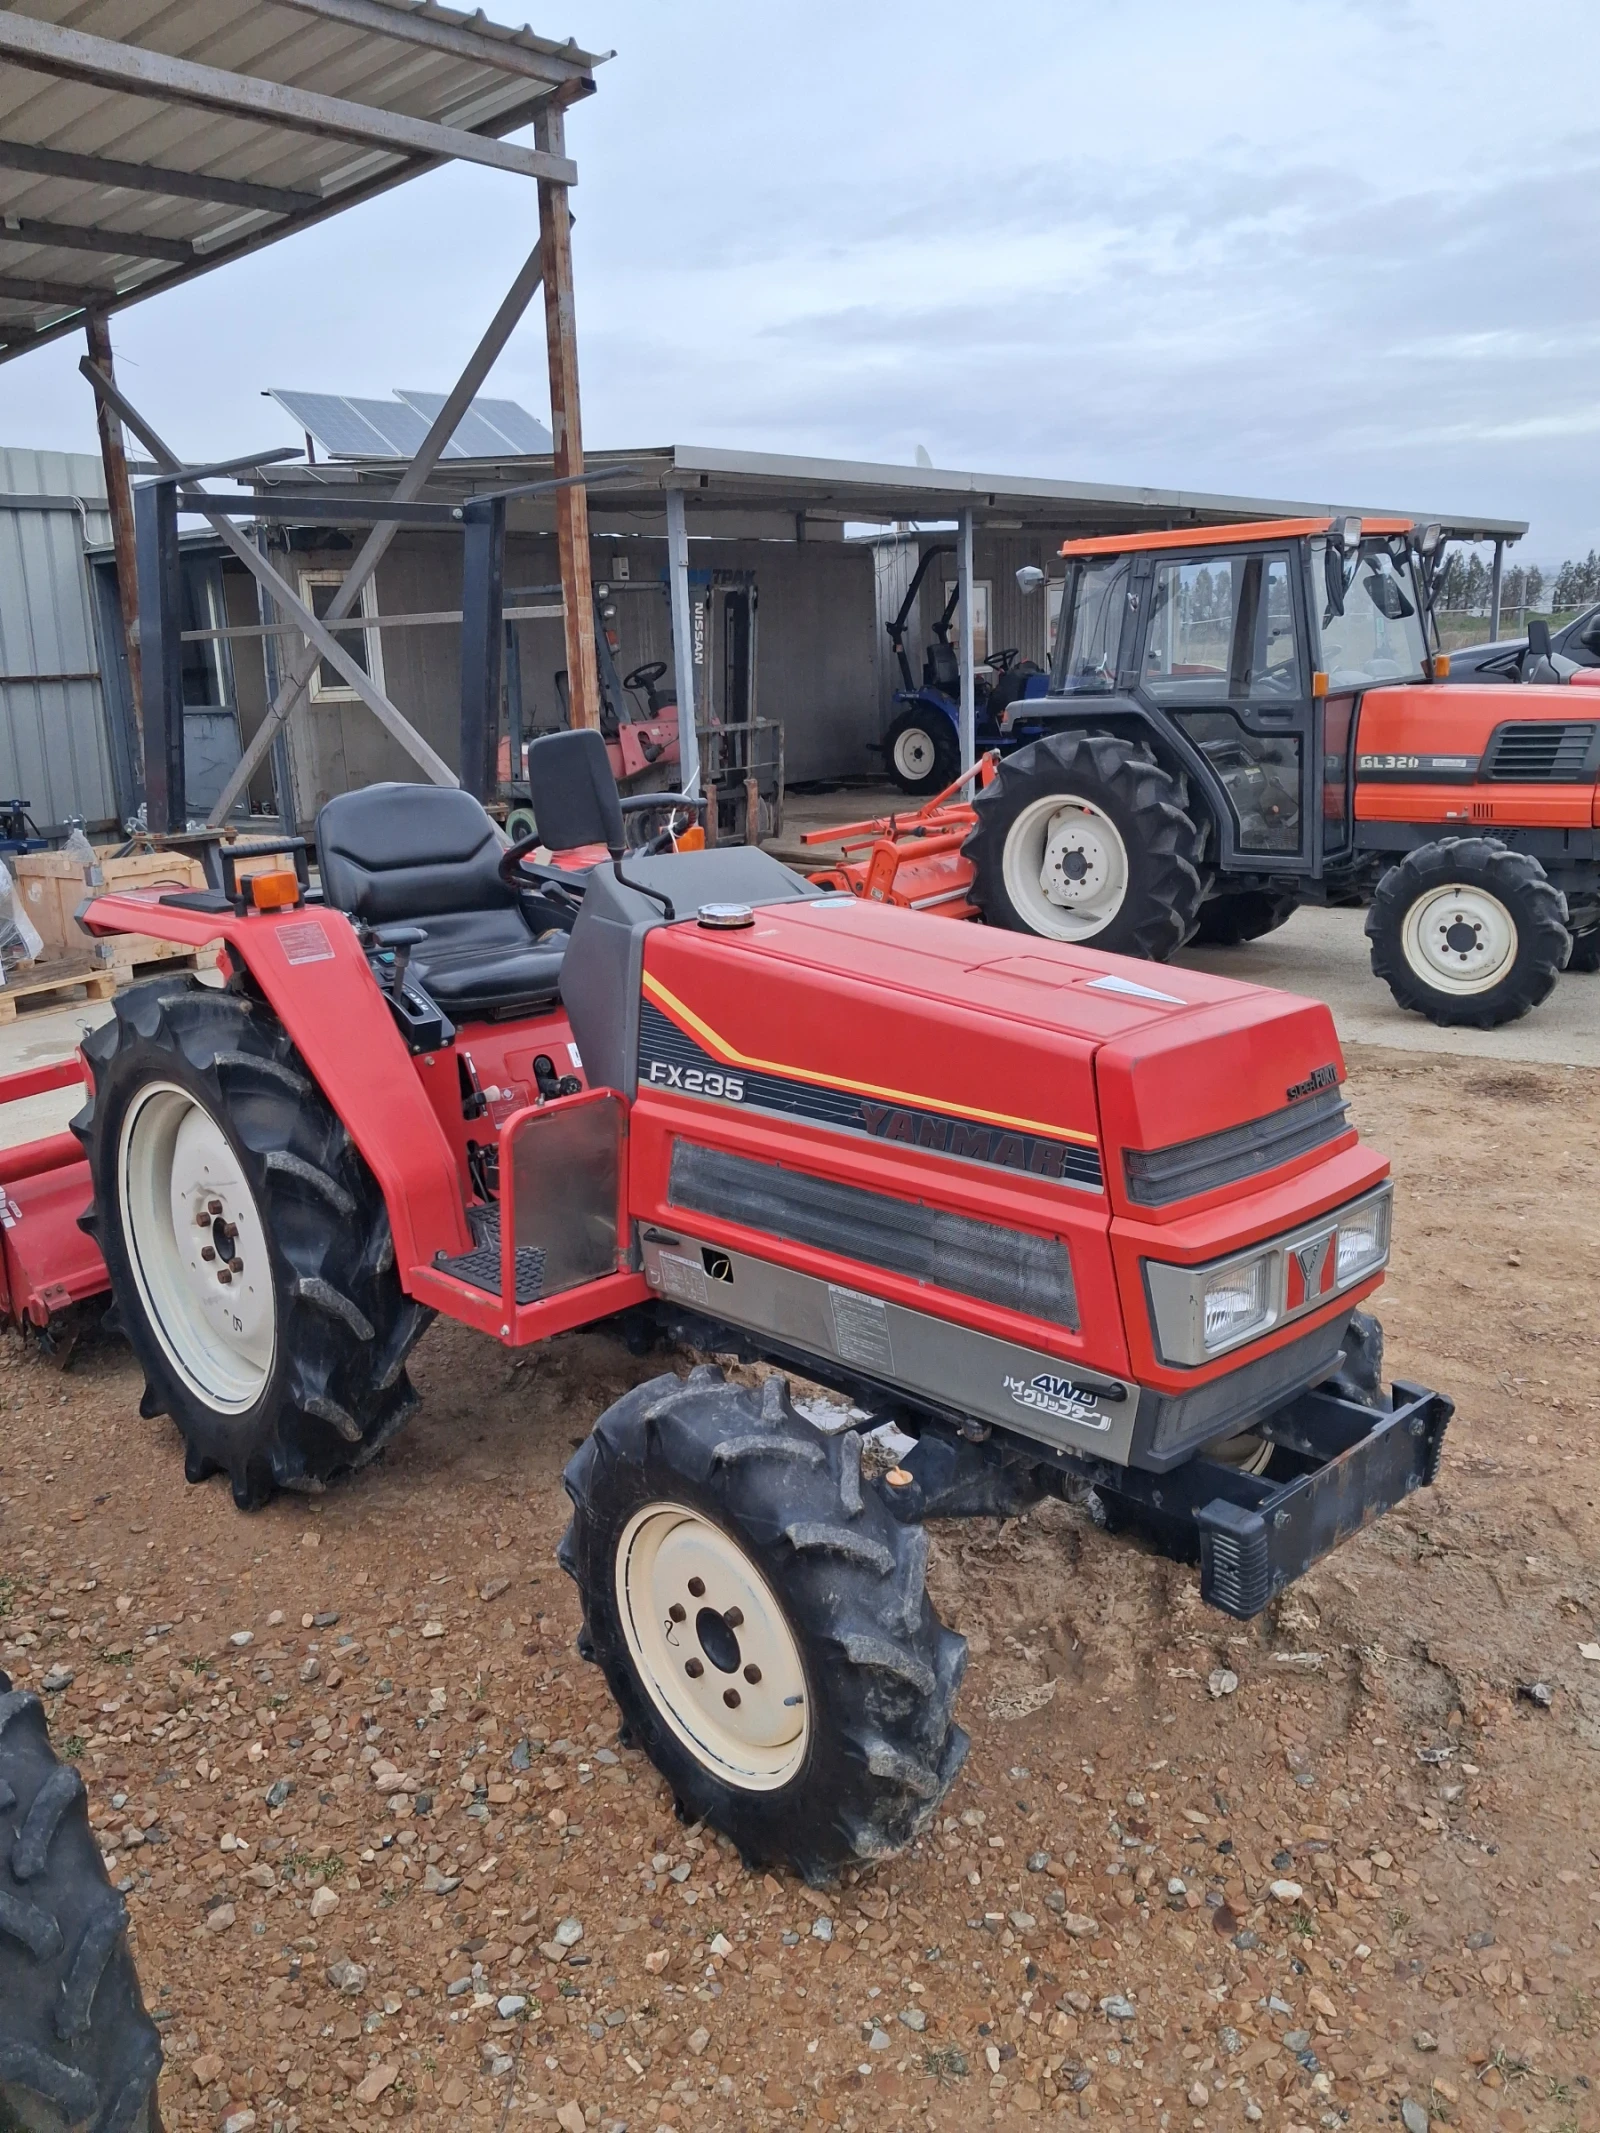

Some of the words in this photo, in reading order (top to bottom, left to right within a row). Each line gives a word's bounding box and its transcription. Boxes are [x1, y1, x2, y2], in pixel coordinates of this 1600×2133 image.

[694, 602, 704, 665] NISSAN
[1360, 756, 1419, 768] GL320
[650, 1060, 745, 1102] FX235
[860, 1102, 1068, 1179] YANMAR
[1031, 1373, 1098, 1408] 4WD
